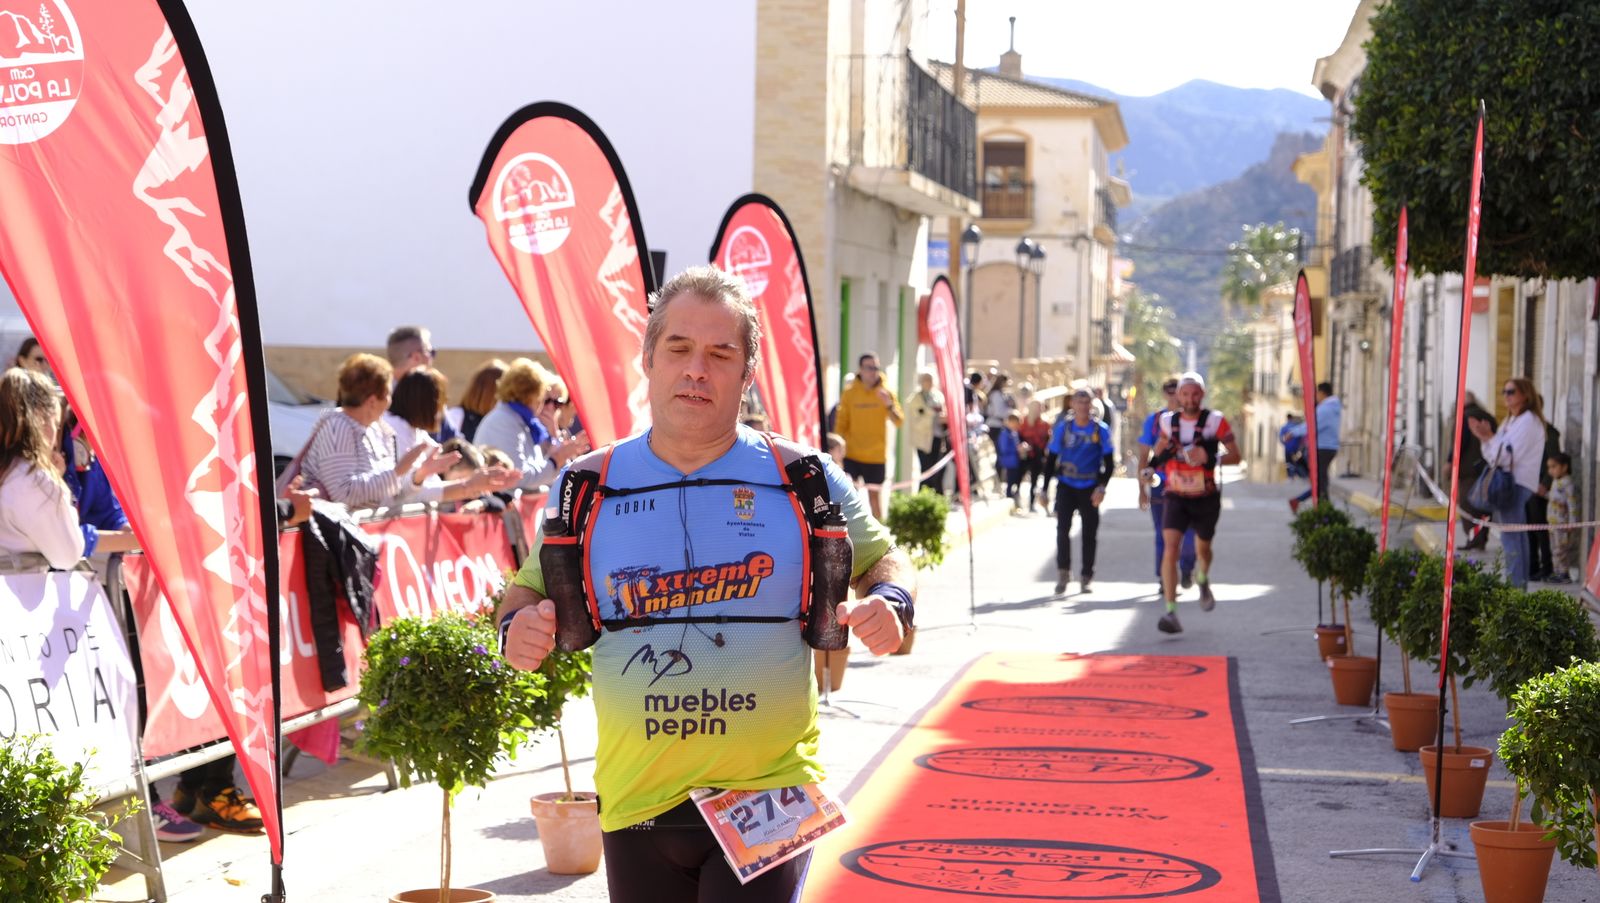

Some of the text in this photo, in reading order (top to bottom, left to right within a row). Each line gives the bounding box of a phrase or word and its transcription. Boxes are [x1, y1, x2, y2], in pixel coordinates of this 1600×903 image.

[615, 498, 656, 516] GOBIK
[644, 575, 762, 613] mandril
[63, 624, 100, 654] DE
[644, 688, 757, 713] muebles
[730, 786, 806, 835] 274
[926, 804, 1169, 820] Ayuntamiento
[1118, 856, 1170, 865] LA
